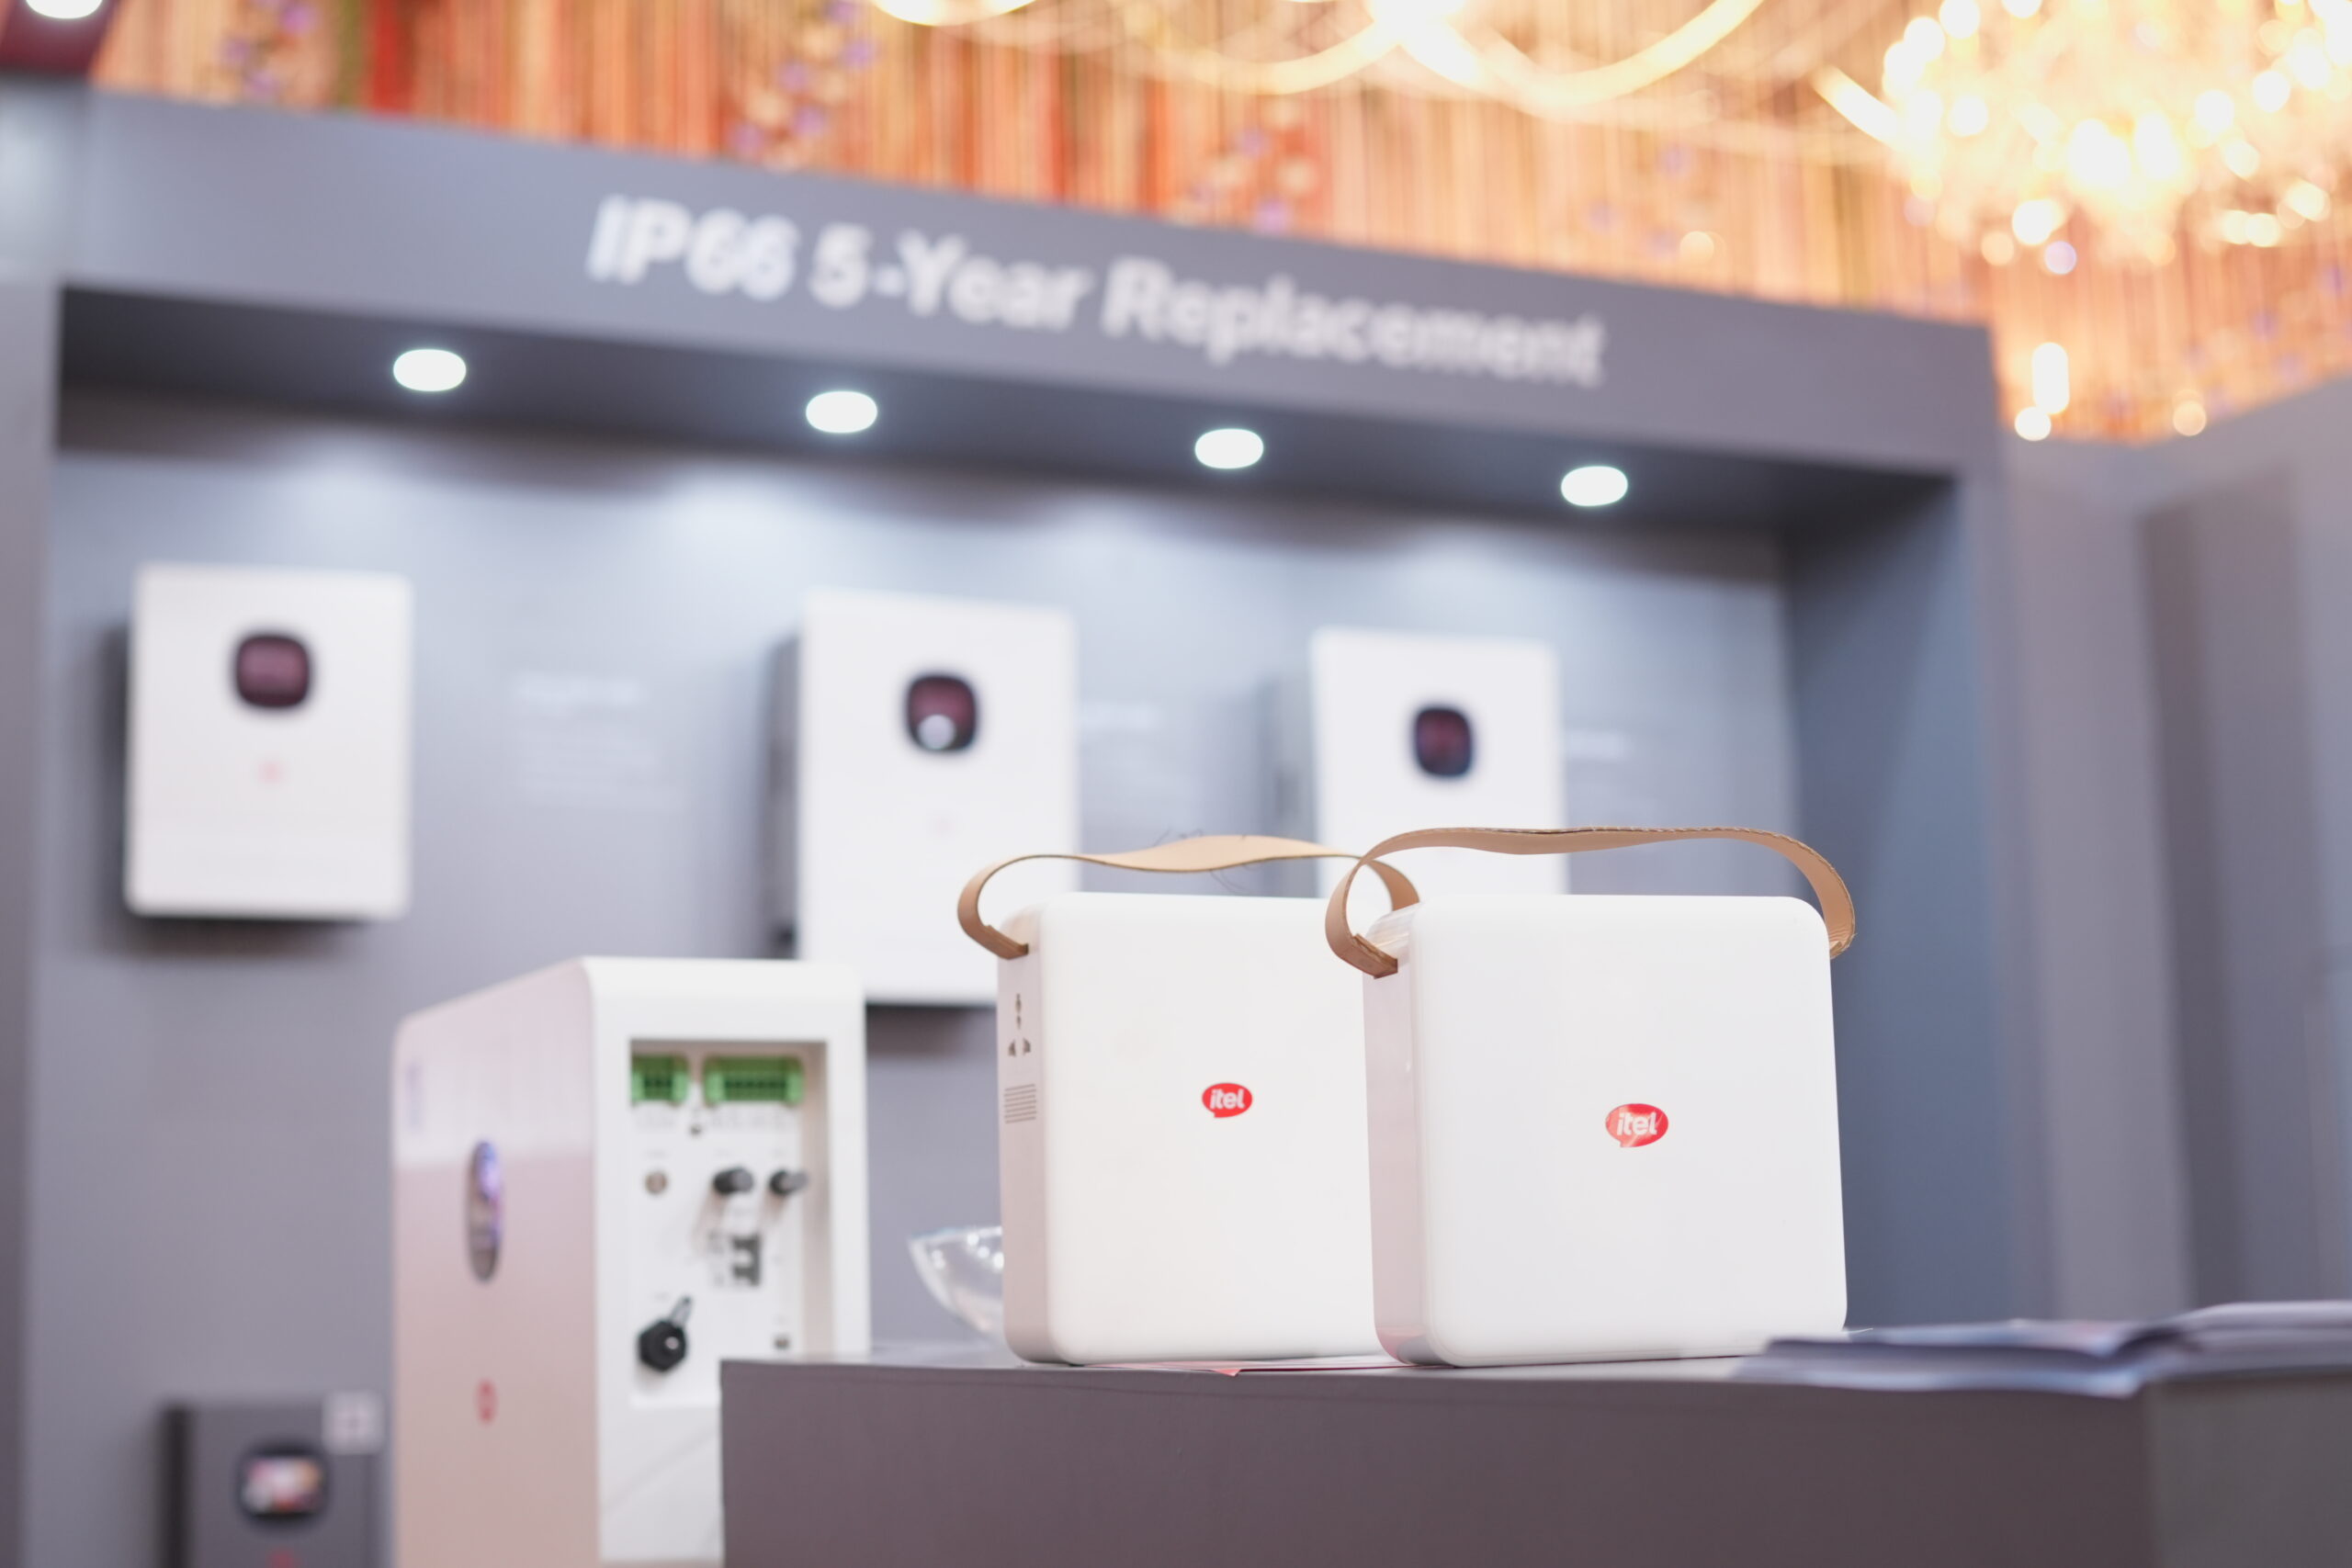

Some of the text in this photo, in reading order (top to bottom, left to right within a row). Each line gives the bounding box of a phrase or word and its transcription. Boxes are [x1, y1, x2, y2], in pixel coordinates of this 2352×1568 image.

[588, 194, 799, 301] IP66
[1101, 255, 1604, 387] Replacement
[1210, 1088, 1246, 1110] itel
[1617, 1111, 1657, 1135] itel
